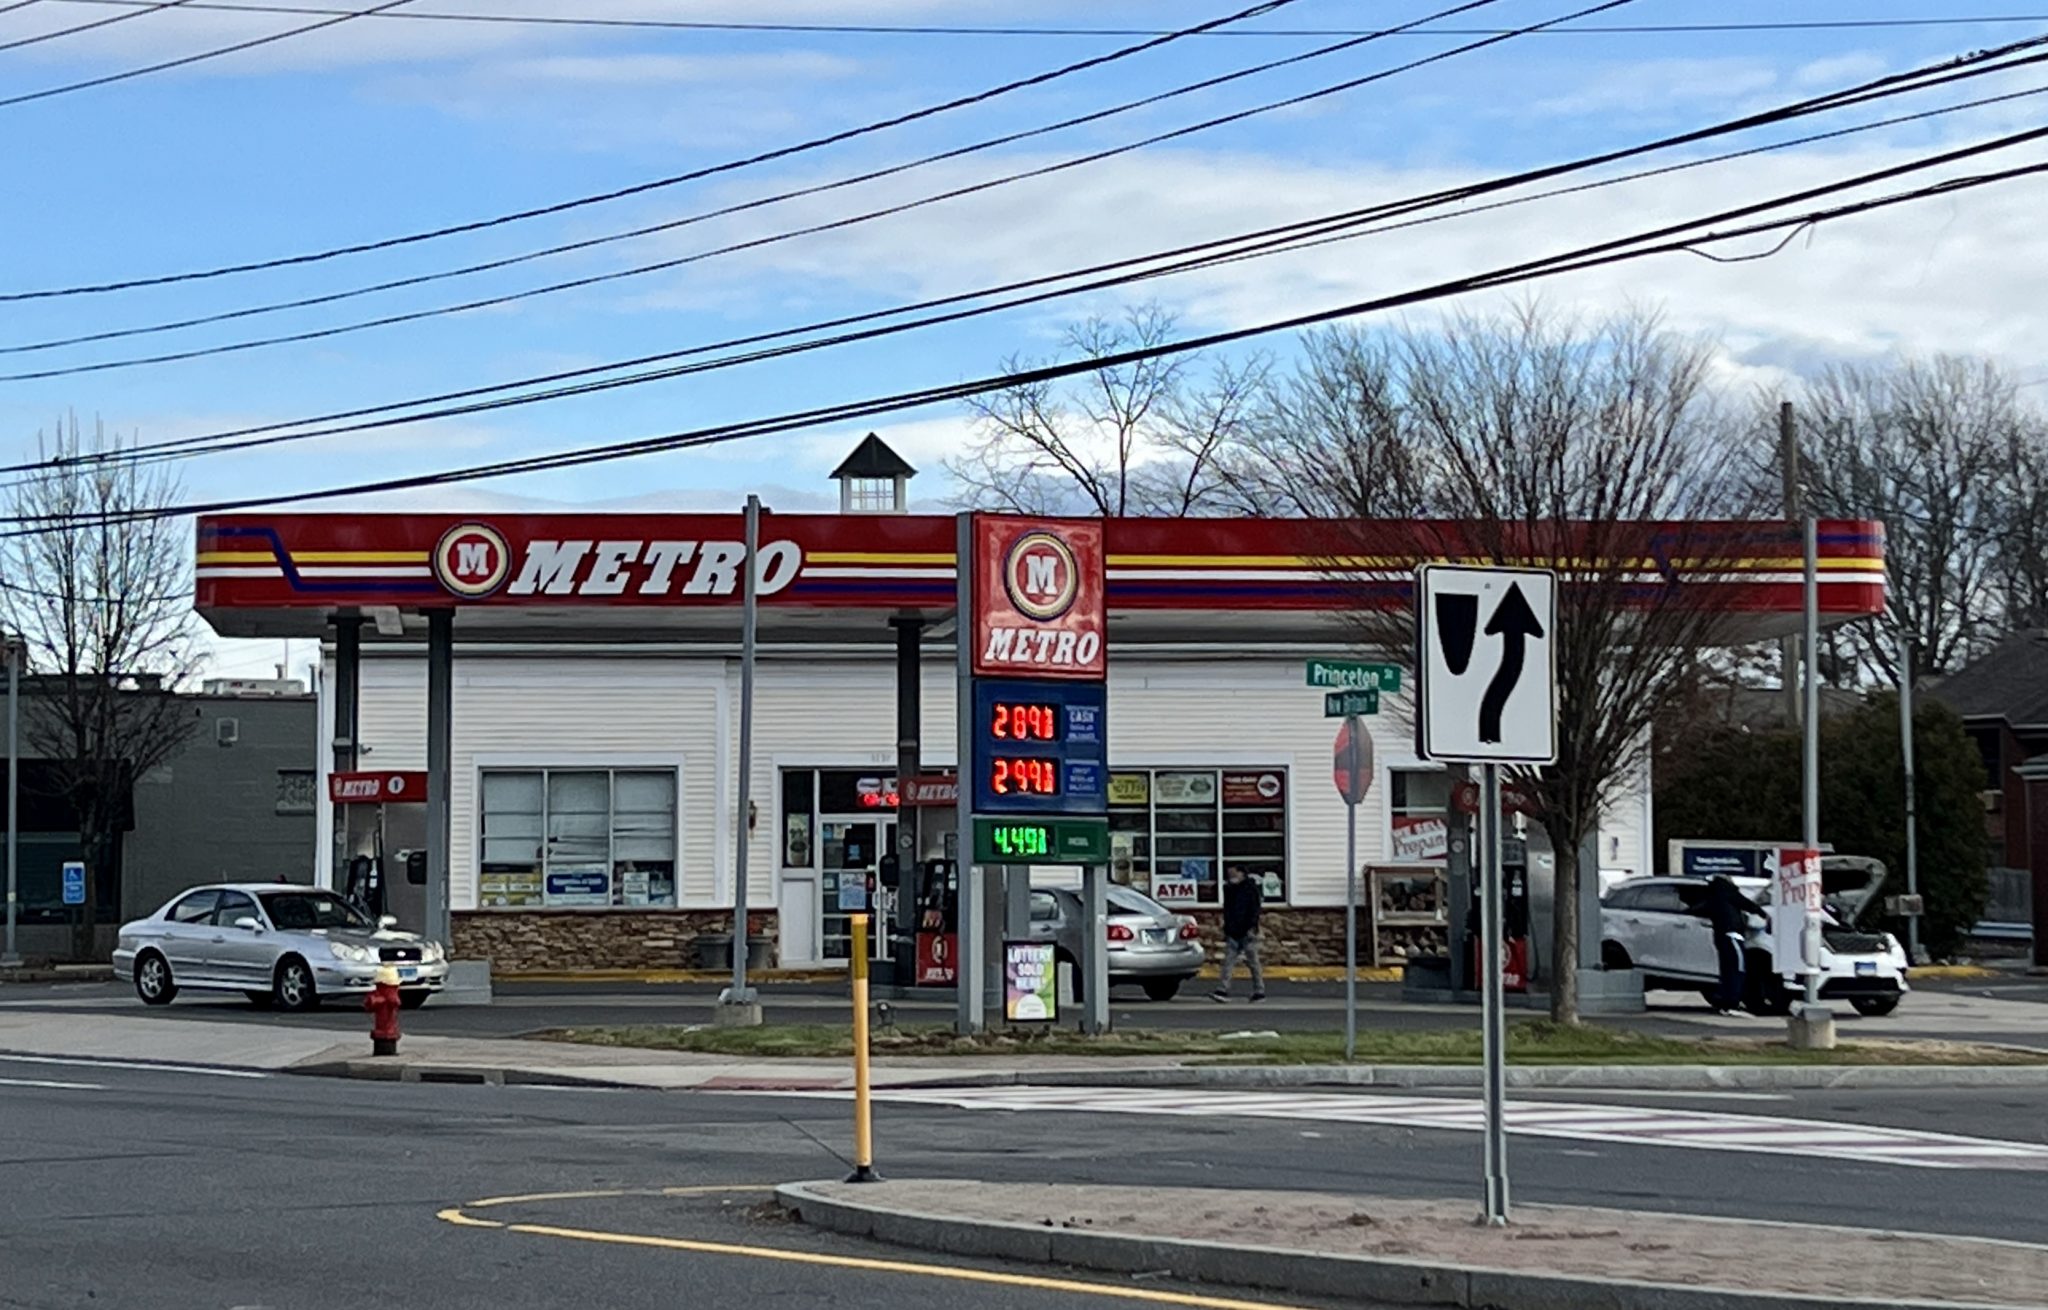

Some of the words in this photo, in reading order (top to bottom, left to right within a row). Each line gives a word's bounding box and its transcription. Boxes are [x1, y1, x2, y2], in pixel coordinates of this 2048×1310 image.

[457, 543, 489, 576] M
[507, 540, 801, 595] METRO
[1026, 555, 1058, 595] M
[984, 627, 1100, 665] METRO
[1314, 664, 1379, 688] Princeton
[1156, 884, 1195, 898] ATM
